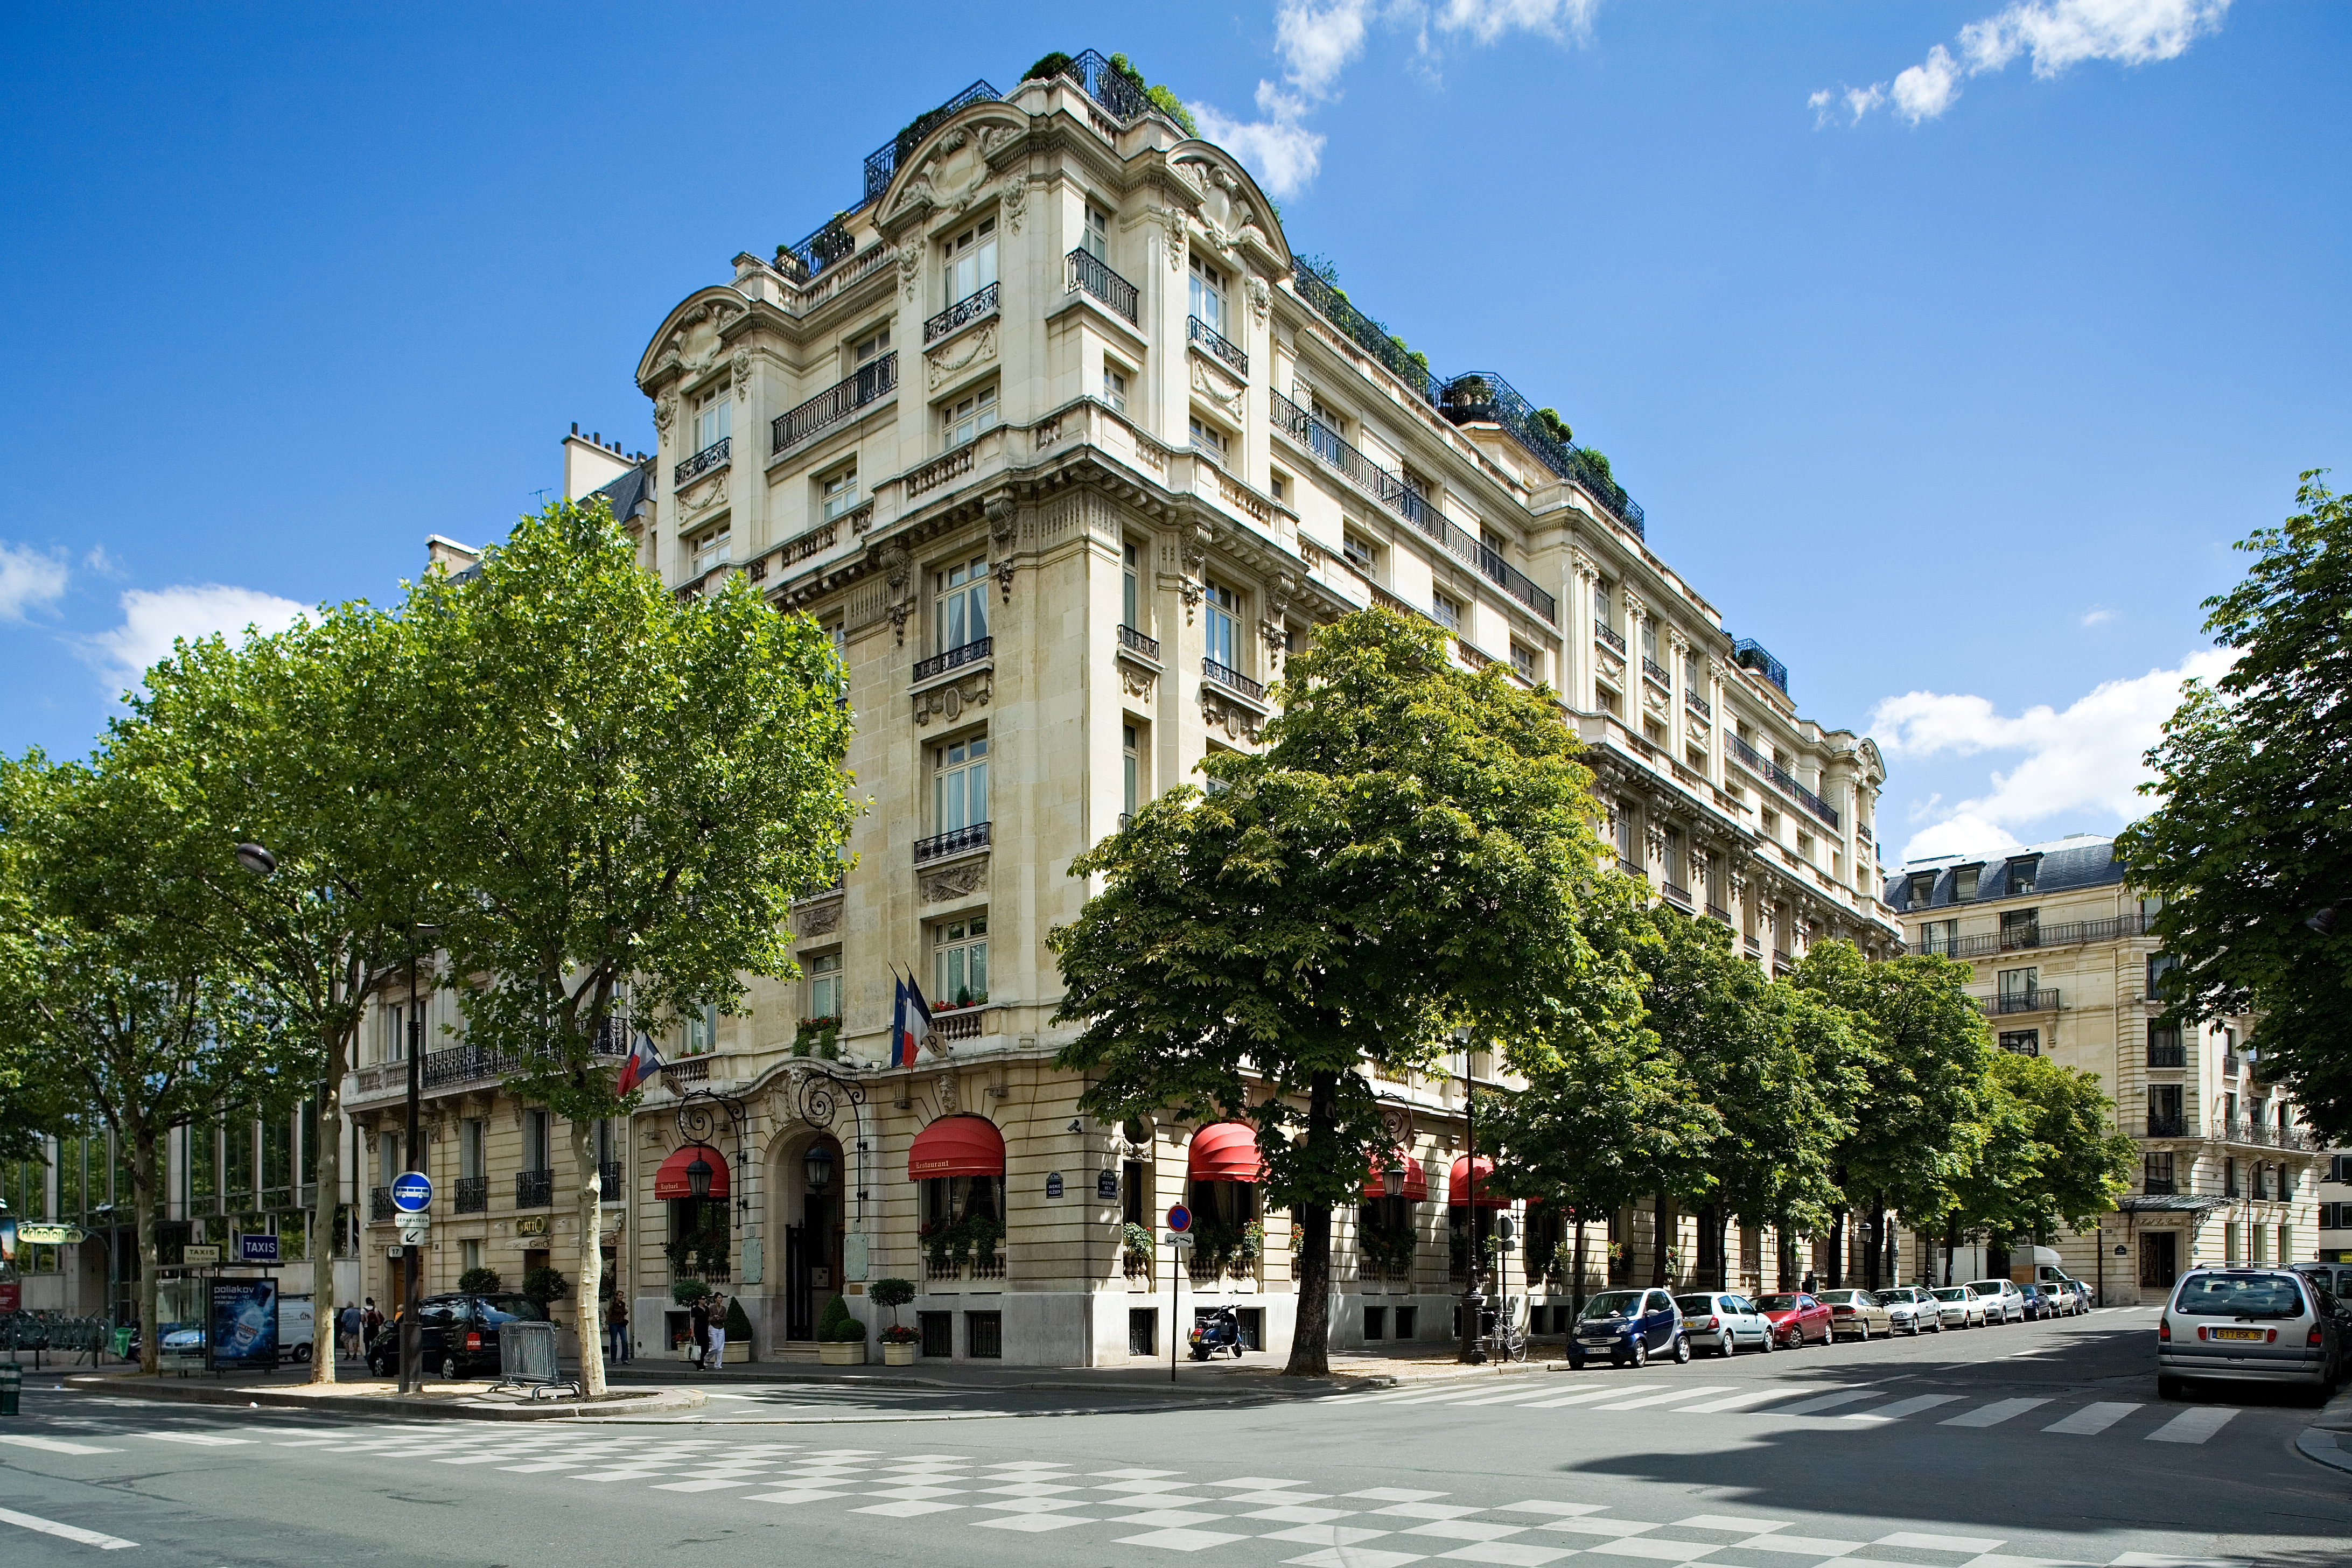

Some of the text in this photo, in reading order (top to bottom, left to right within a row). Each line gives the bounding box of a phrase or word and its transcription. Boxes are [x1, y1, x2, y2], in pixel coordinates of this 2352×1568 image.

[926, 1035, 942, 1052] R
[666, 1079, 680, 1093] R
[915, 1160, 949, 1169] Restaurant
[246, 1242, 276, 1253] TAXIS
[214, 1285, 255, 1294] poliakov
